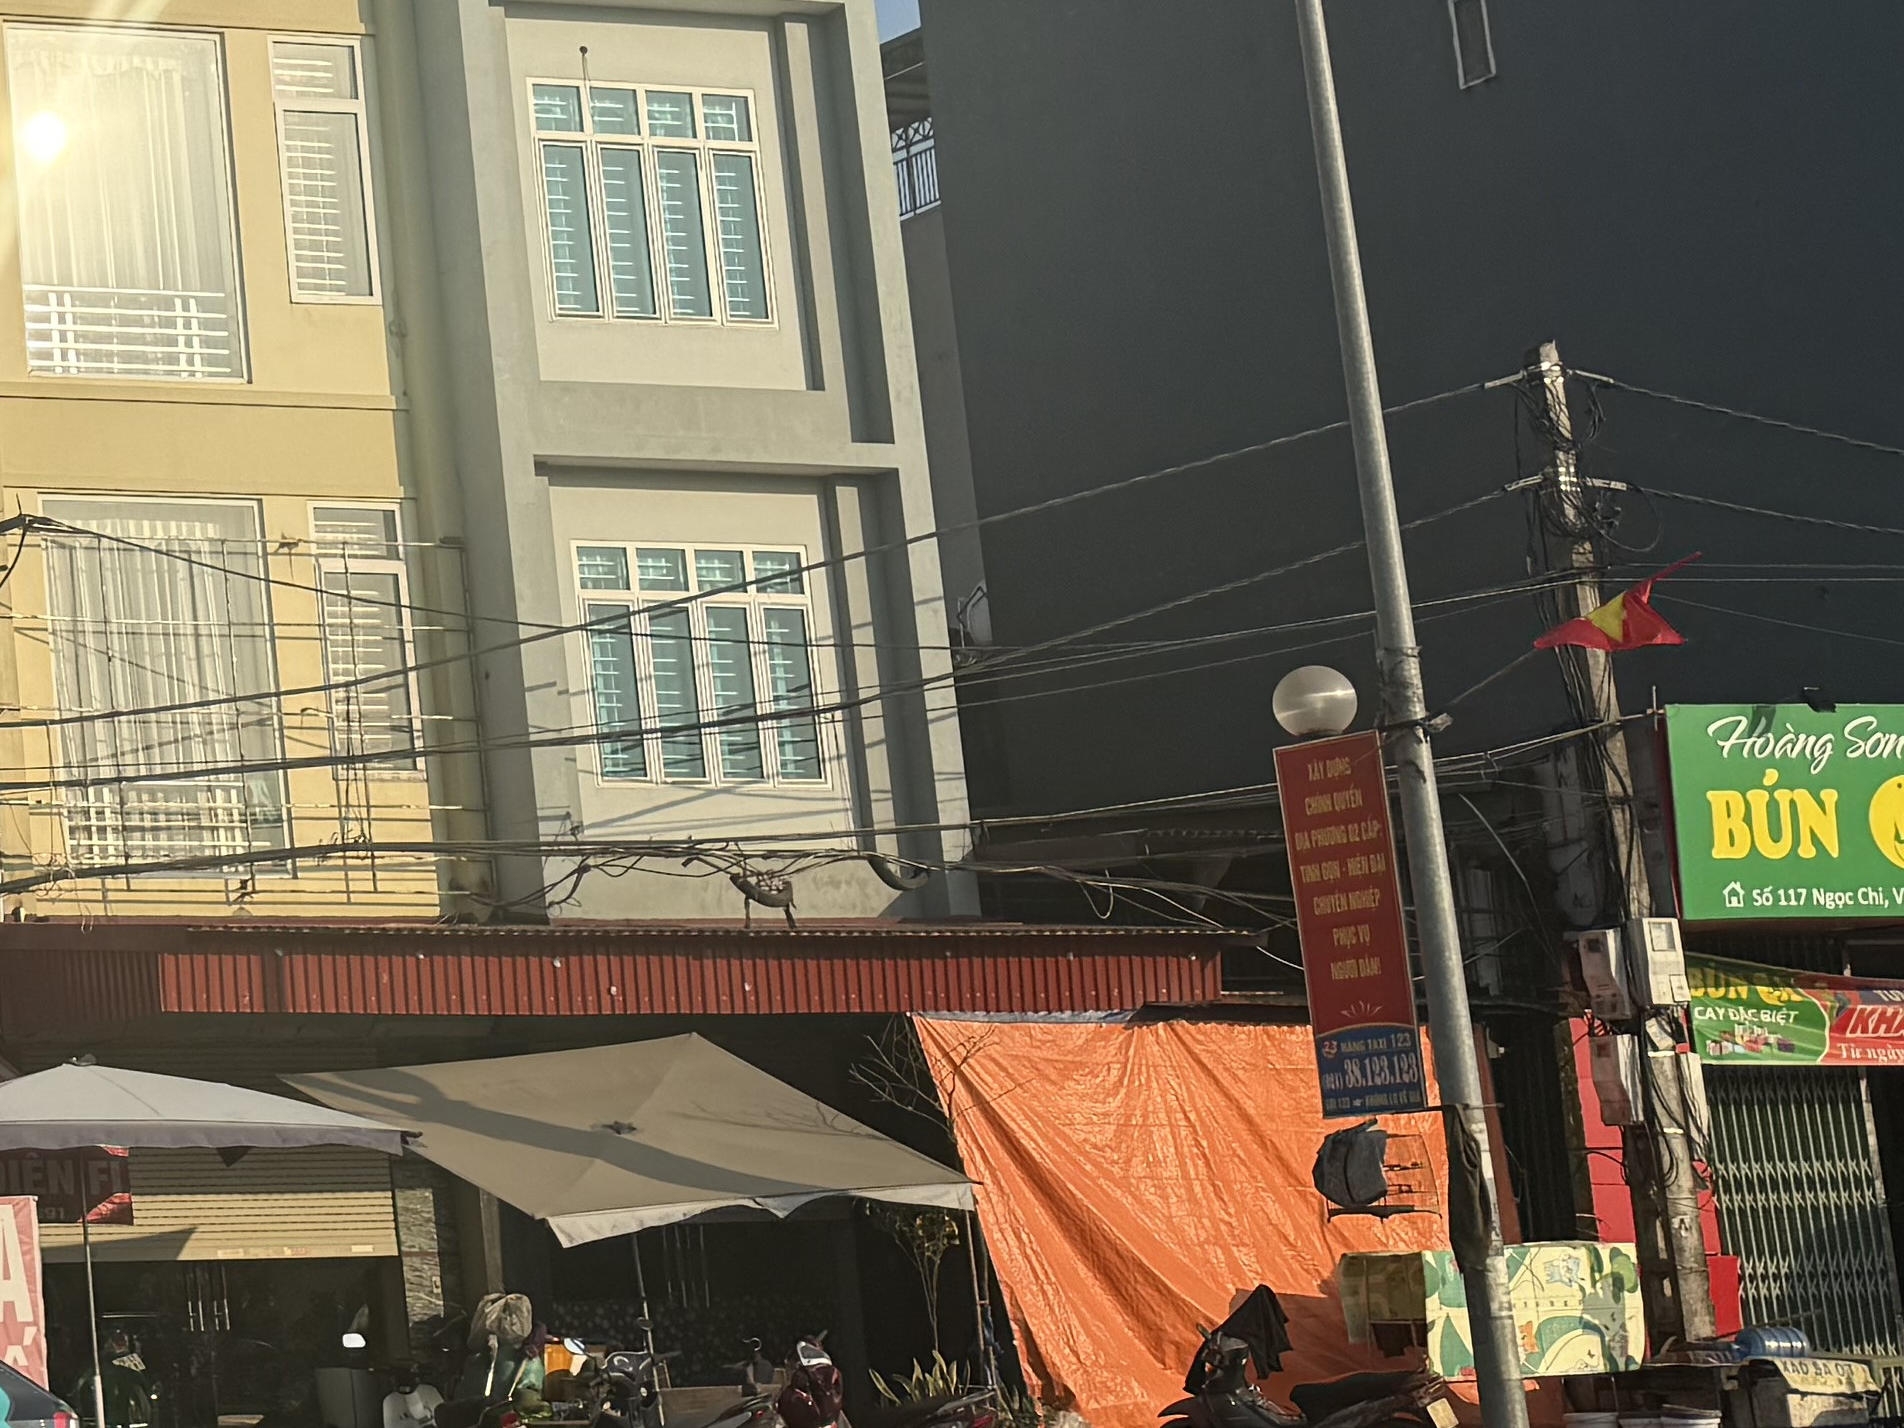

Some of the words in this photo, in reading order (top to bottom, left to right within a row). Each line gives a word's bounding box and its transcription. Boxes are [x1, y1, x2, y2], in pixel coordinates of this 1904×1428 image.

[1706, 715, 1835, 775] Hoàng
[1706, 768, 1839, 859] BÚN
[1752, 885, 1773, 906] Số
[1778, 888, 1807, 906] 117
[1812, 887, 1854, 910] Ngọc
[1857, 886, 1889, 908] Chi,
[1694, 1006, 1726, 1022] CAY
